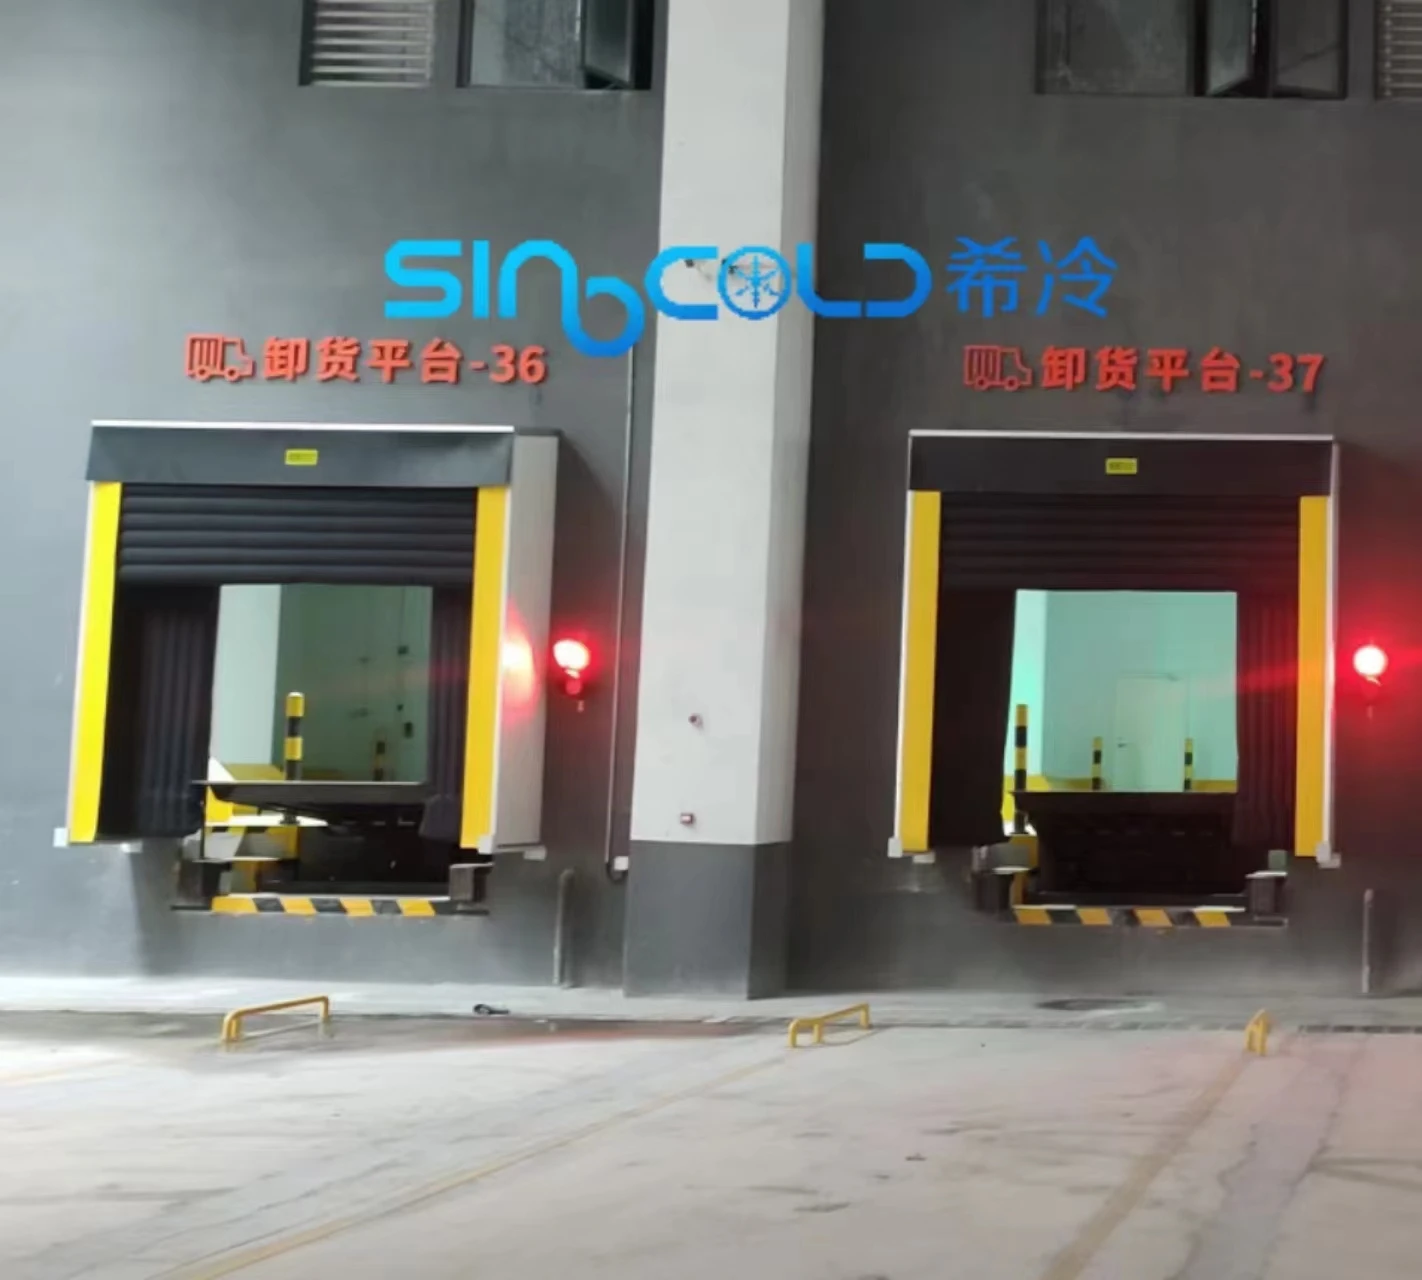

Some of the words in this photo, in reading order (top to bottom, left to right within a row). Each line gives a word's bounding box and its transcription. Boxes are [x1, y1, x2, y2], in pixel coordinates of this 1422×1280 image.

[264, 336, 547, 384] 卸货平台-36
[1041, 345, 1324, 393] 卸货平台-37
